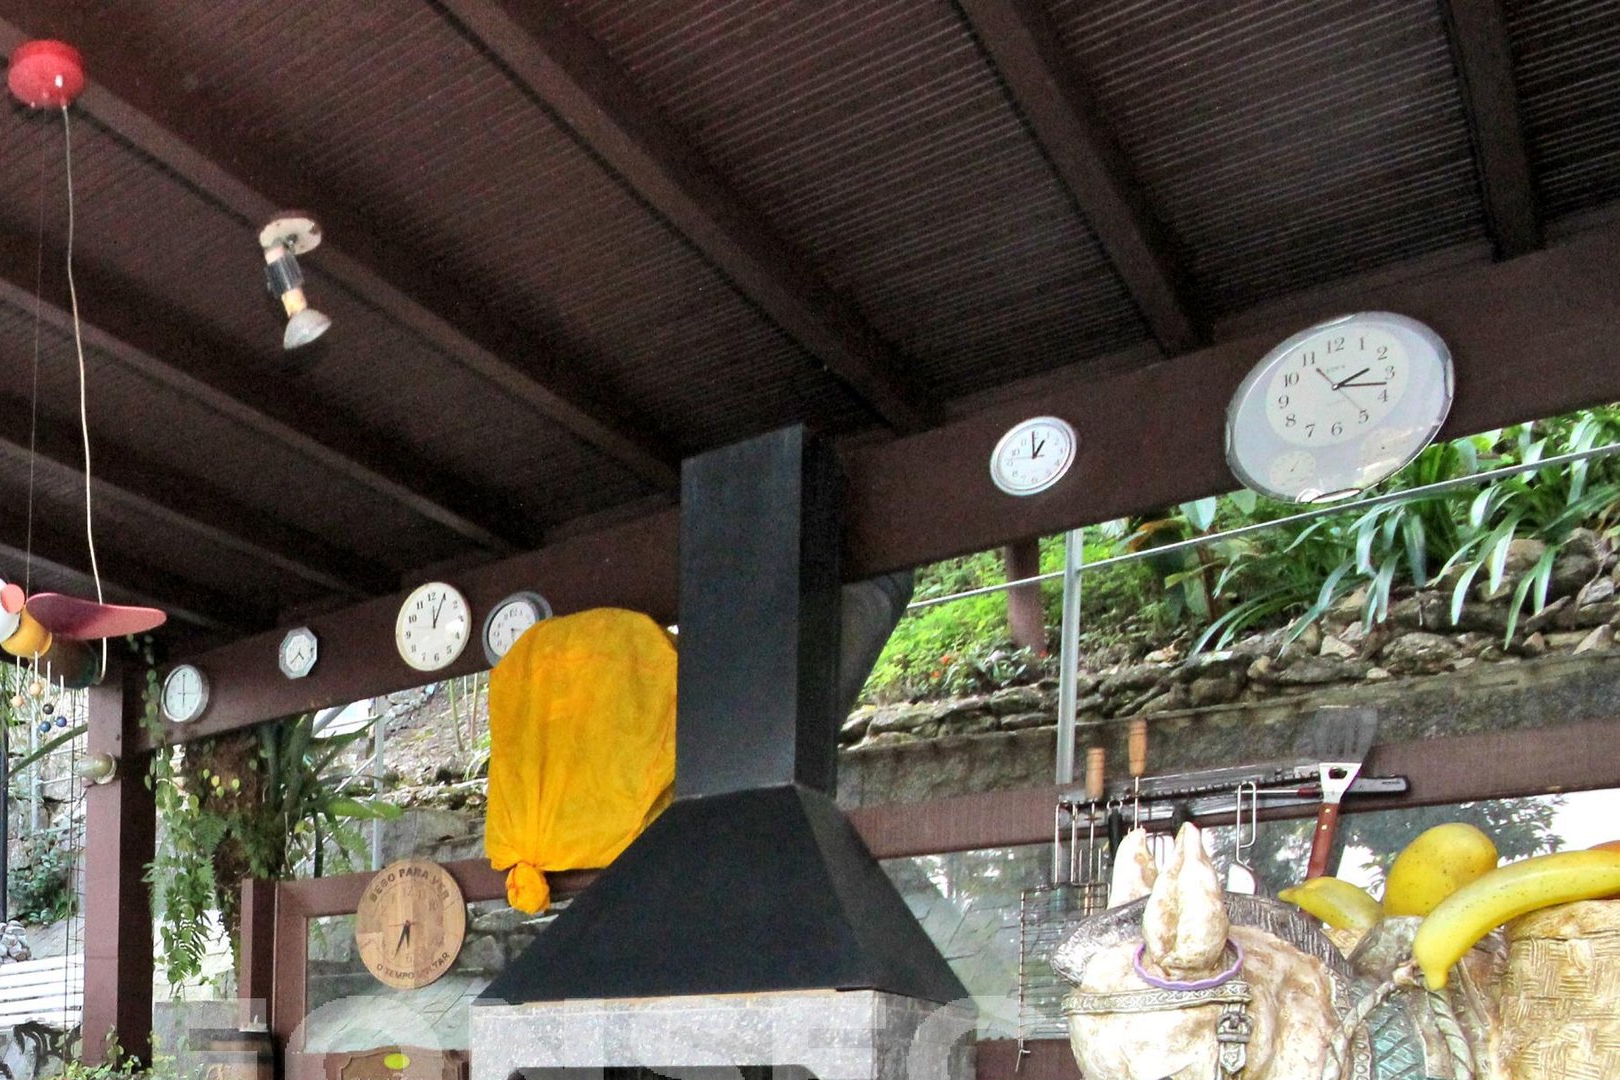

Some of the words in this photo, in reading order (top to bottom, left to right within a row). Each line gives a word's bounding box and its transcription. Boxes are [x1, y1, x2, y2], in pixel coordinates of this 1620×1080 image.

[1327, 337, 1345, 353] 12
[1359, 337, 1365, 350] 1
[1302, 352, 1316, 367] 11
[1376, 346, 1388, 360] 2
[1283, 372, 1299, 387] 10
[1385, 366, 1395, 380] 3
[1278, 395, 1289, 410] 9
[1379, 389, 1388, 402] 4
[1285, 414, 1297, 428] 8
[1358, 409, 1369, 424] 5
[1305, 423, 1316, 438] 7
[1331, 421, 1343, 436] 6
[427, 592, 436, 601] 12
[409, 614, 417, 624] 10
[369, 873, 396, 902] BEBO
[398, 867, 429, 880] PARA
[376, 963, 384, 972] O
[384, 967, 415, 980] TEMPO
